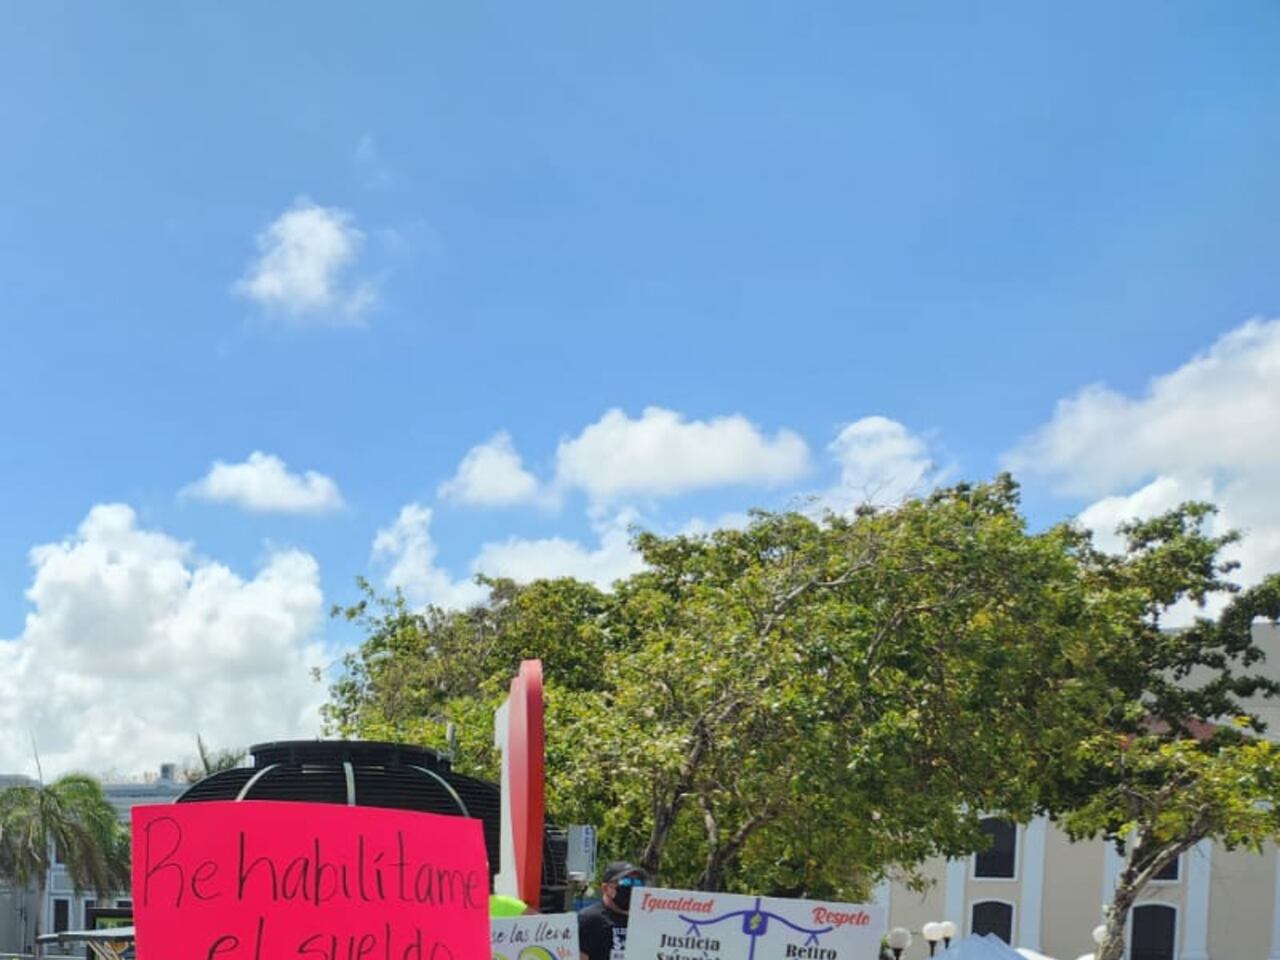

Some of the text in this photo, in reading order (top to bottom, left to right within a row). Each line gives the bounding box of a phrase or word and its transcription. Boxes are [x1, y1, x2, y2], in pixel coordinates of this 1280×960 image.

[642, 893, 714, 913] Igualdad
[812, 906, 870, 927] Respeto
[659, 934, 720, 951] Justicia
[786, 943, 837, 960] Retiro
